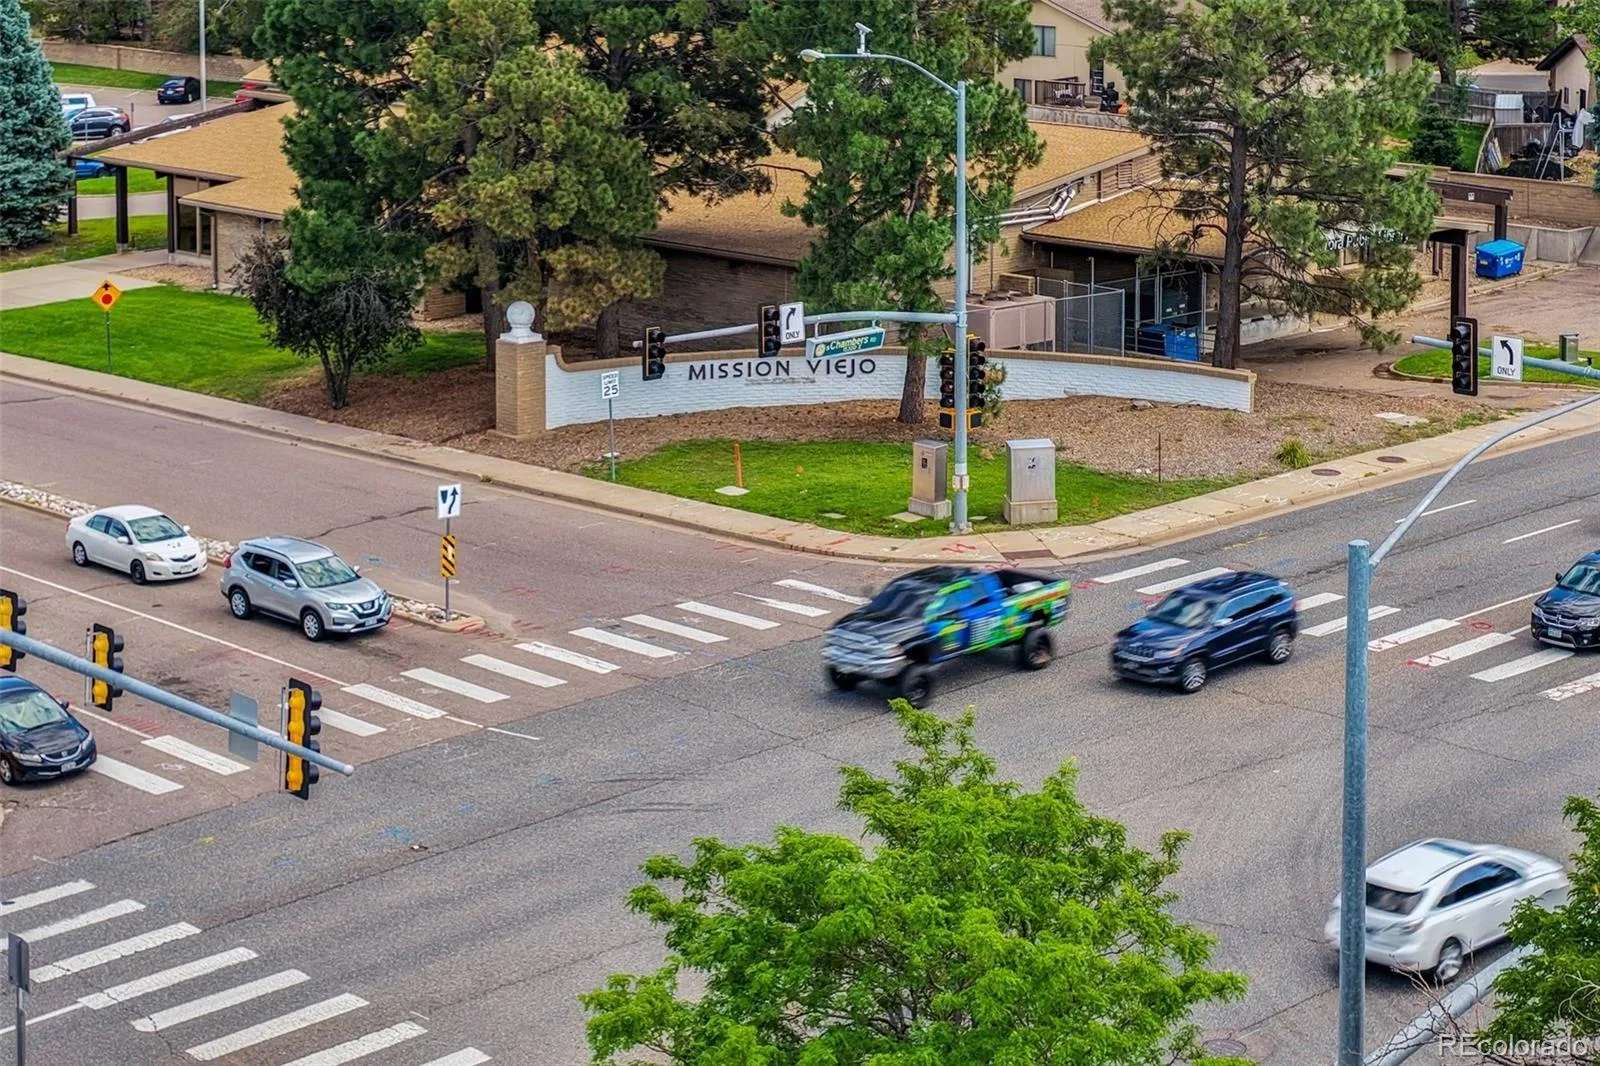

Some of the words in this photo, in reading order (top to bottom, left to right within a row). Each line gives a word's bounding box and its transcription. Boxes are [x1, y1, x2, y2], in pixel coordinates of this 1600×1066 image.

[785, 330, 800, 340] ONLY
[830, 335, 869, 350] Chambers
[688, 361, 791, 380] MISSION
[806, 358, 876, 378] VIEJO
[1497, 366, 1516, 376] ONLY
[604, 384, 618, 397] 25
